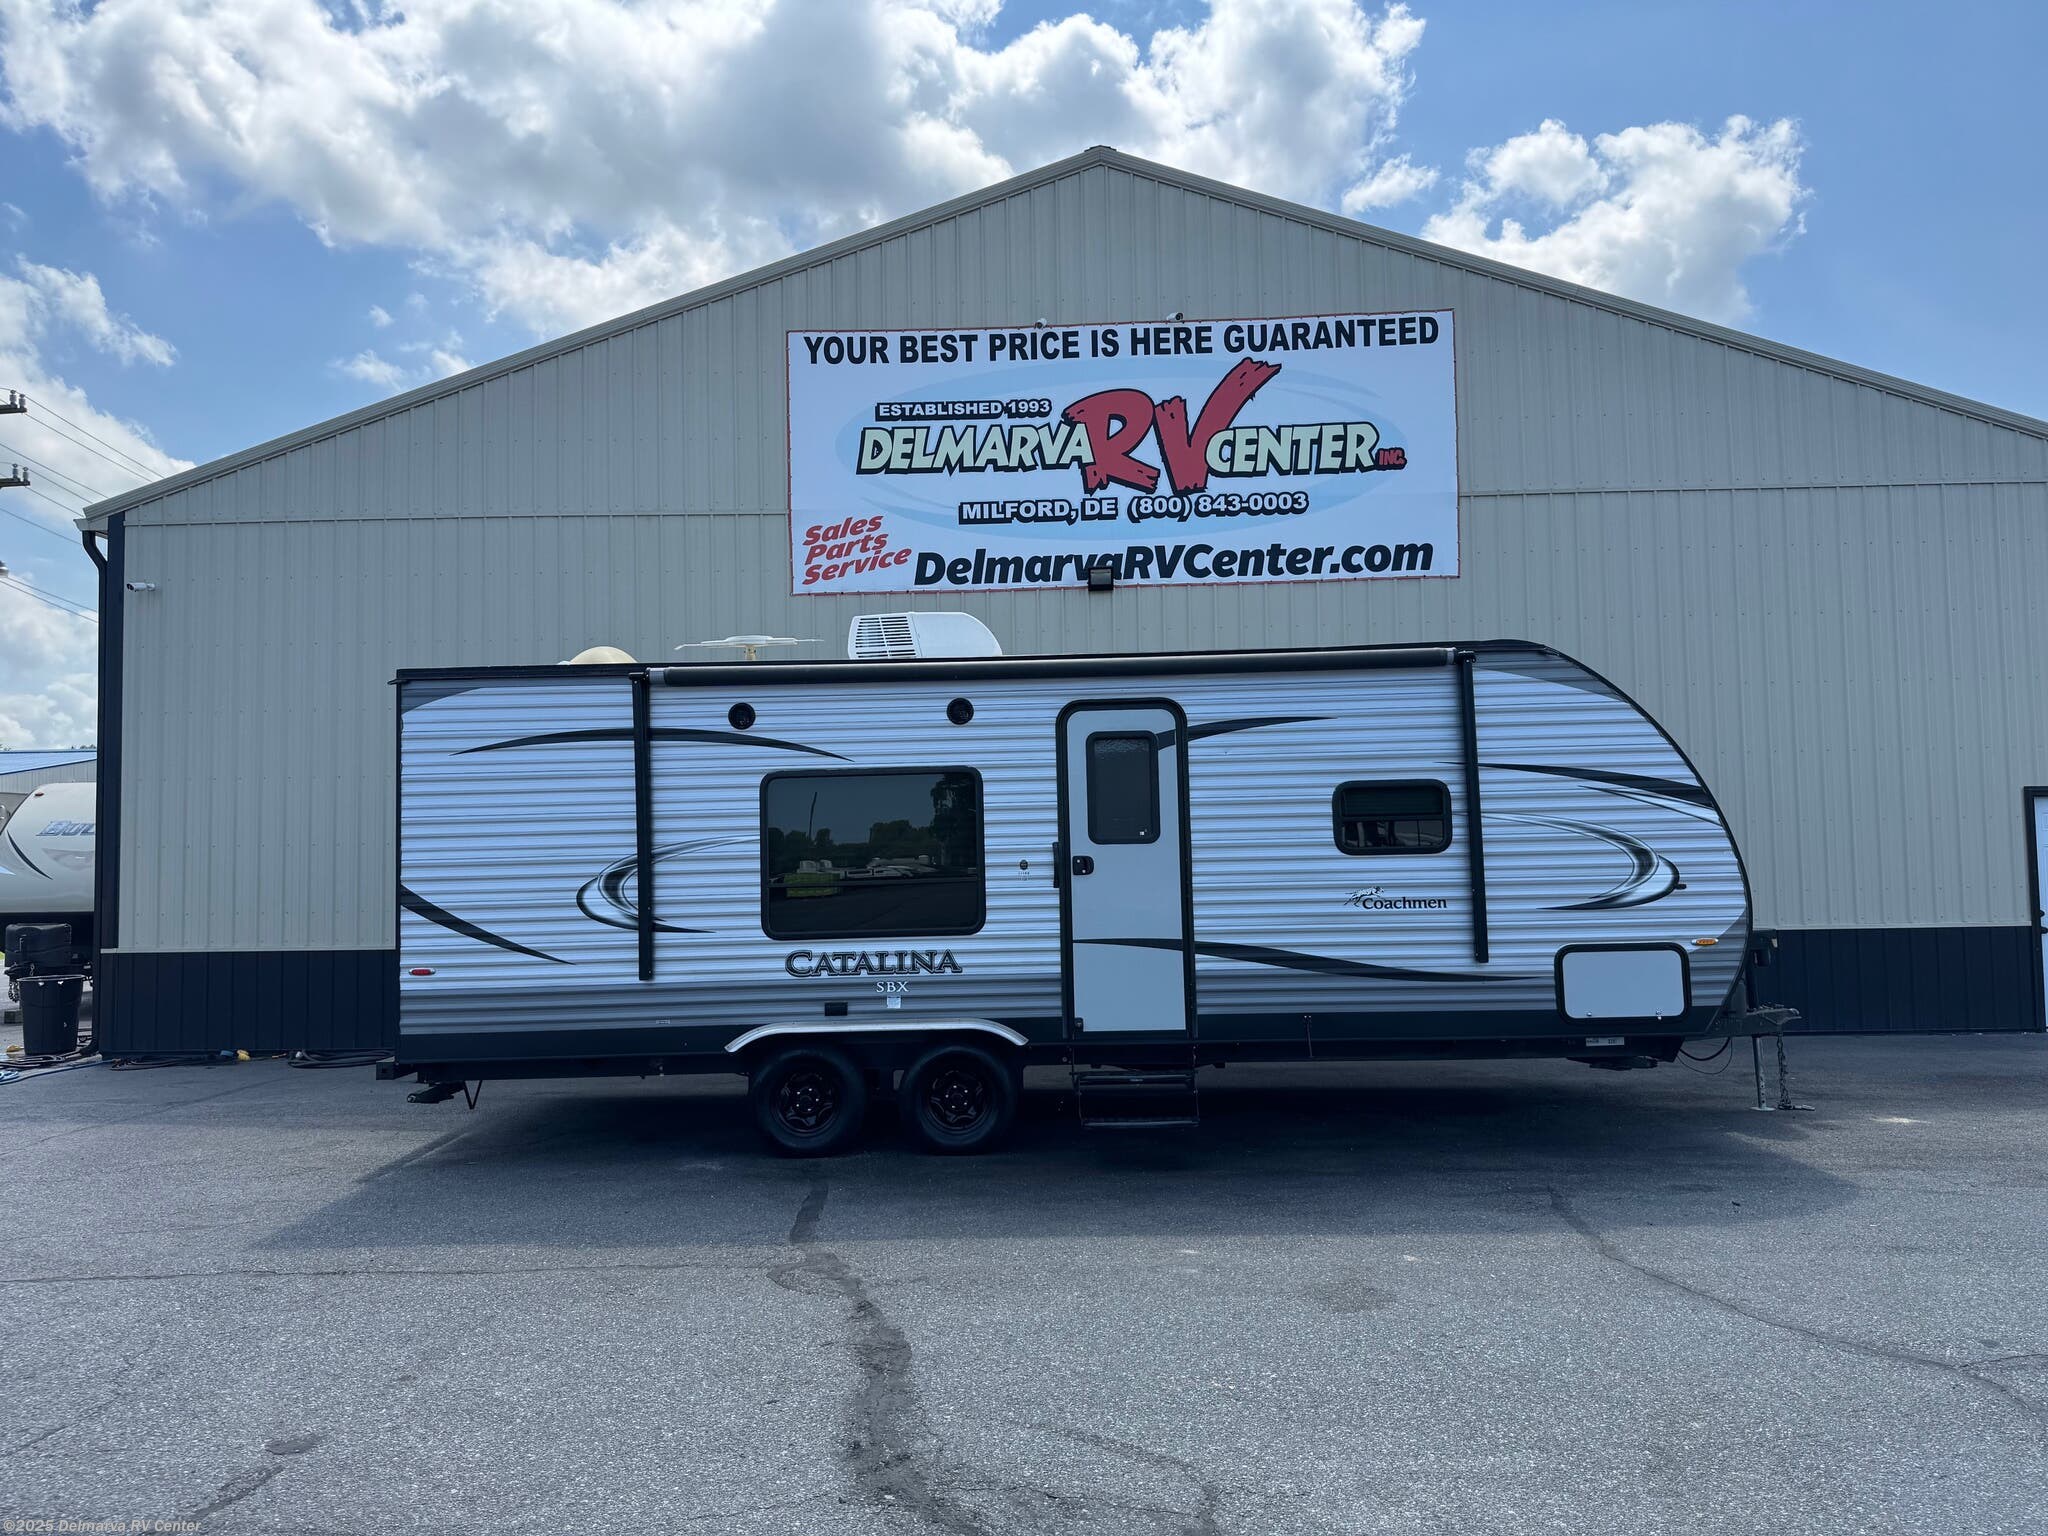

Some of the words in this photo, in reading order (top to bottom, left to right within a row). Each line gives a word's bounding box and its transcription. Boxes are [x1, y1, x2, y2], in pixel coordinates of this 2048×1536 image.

[803, 336, 890, 365] YOUR
[900, 334, 979, 363] BEST
[989, 330, 1080, 361] PRICE
[1090, 328, 1120, 358] IS
[1130, 325, 1213, 356] HERE
[1223, 316, 1439, 353] GUARANTEED
[877, 400, 1002, 419] ESTABLISHED
[1006, 398, 1051, 416] 1993
[857, 422, 1094, 475] DELMARVA
[1062, 357, 1282, 494] RV
[1206, 422, 1379, 477] CENTER
[1376, 447, 1407, 470] INC.
[960, 500, 1079, 525] MILFORD,
[1083, 498, 1118, 520] DE
[1128, 496, 1192, 522] (800)
[1198, 492, 1309, 516] 843-0003
[802, 515, 884, 545] Sales
[804, 533, 889, 565] Parts
[914, 542, 1434, 586] DelmarvaRVCenter.com
[802, 548, 912, 585] Service
[1362, 896, 1448, 910] Coachmen
[784, 949, 963, 978] CATALINA
[876, 981, 909, 993] SBX
